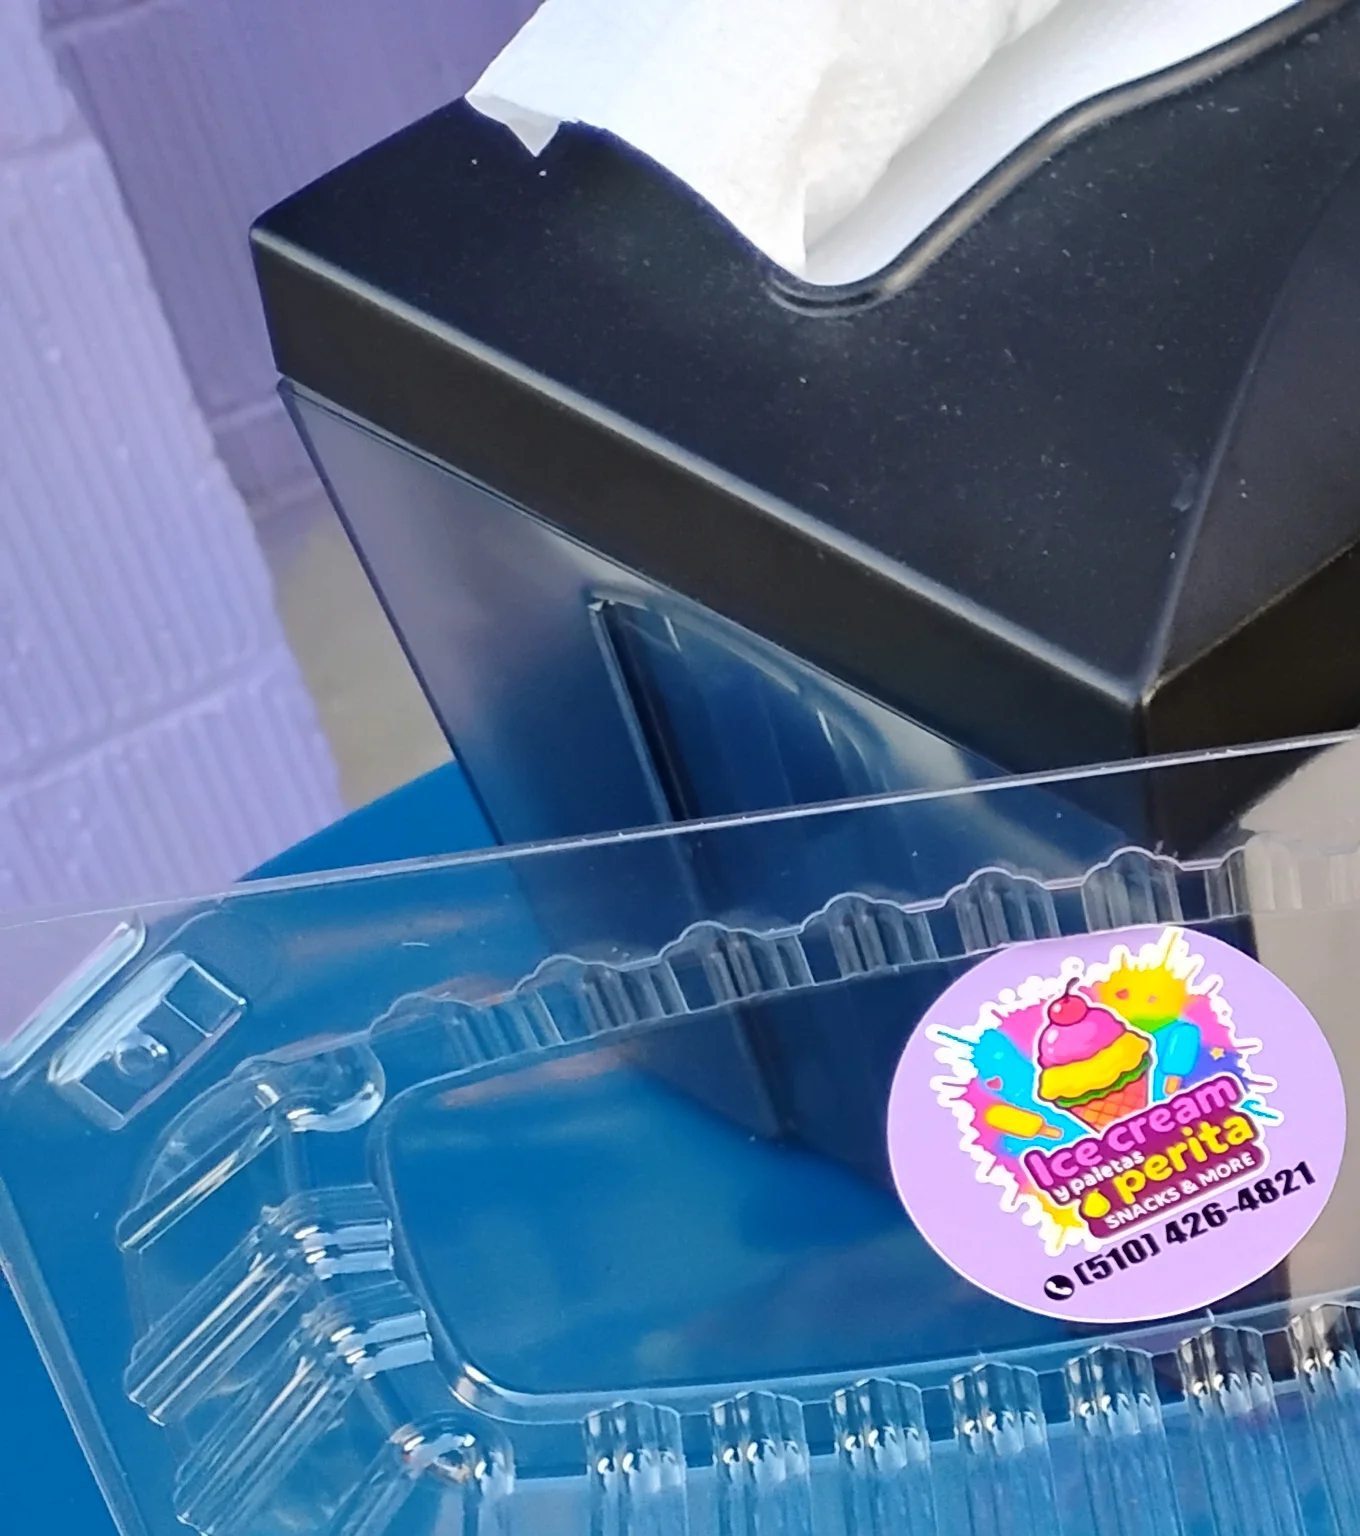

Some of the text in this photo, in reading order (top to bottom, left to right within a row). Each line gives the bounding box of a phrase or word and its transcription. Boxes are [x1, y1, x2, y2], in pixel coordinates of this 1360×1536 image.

[1028, 1079, 1237, 1186] Ice cream
[1053, 1150, 1146, 1201] y paletas
[1113, 1115, 1255, 1205] perita
[1073, 1161, 1316, 1286] (510) 426-4821
[1105, 1151, 1256, 1229] SNACKS & MORE
